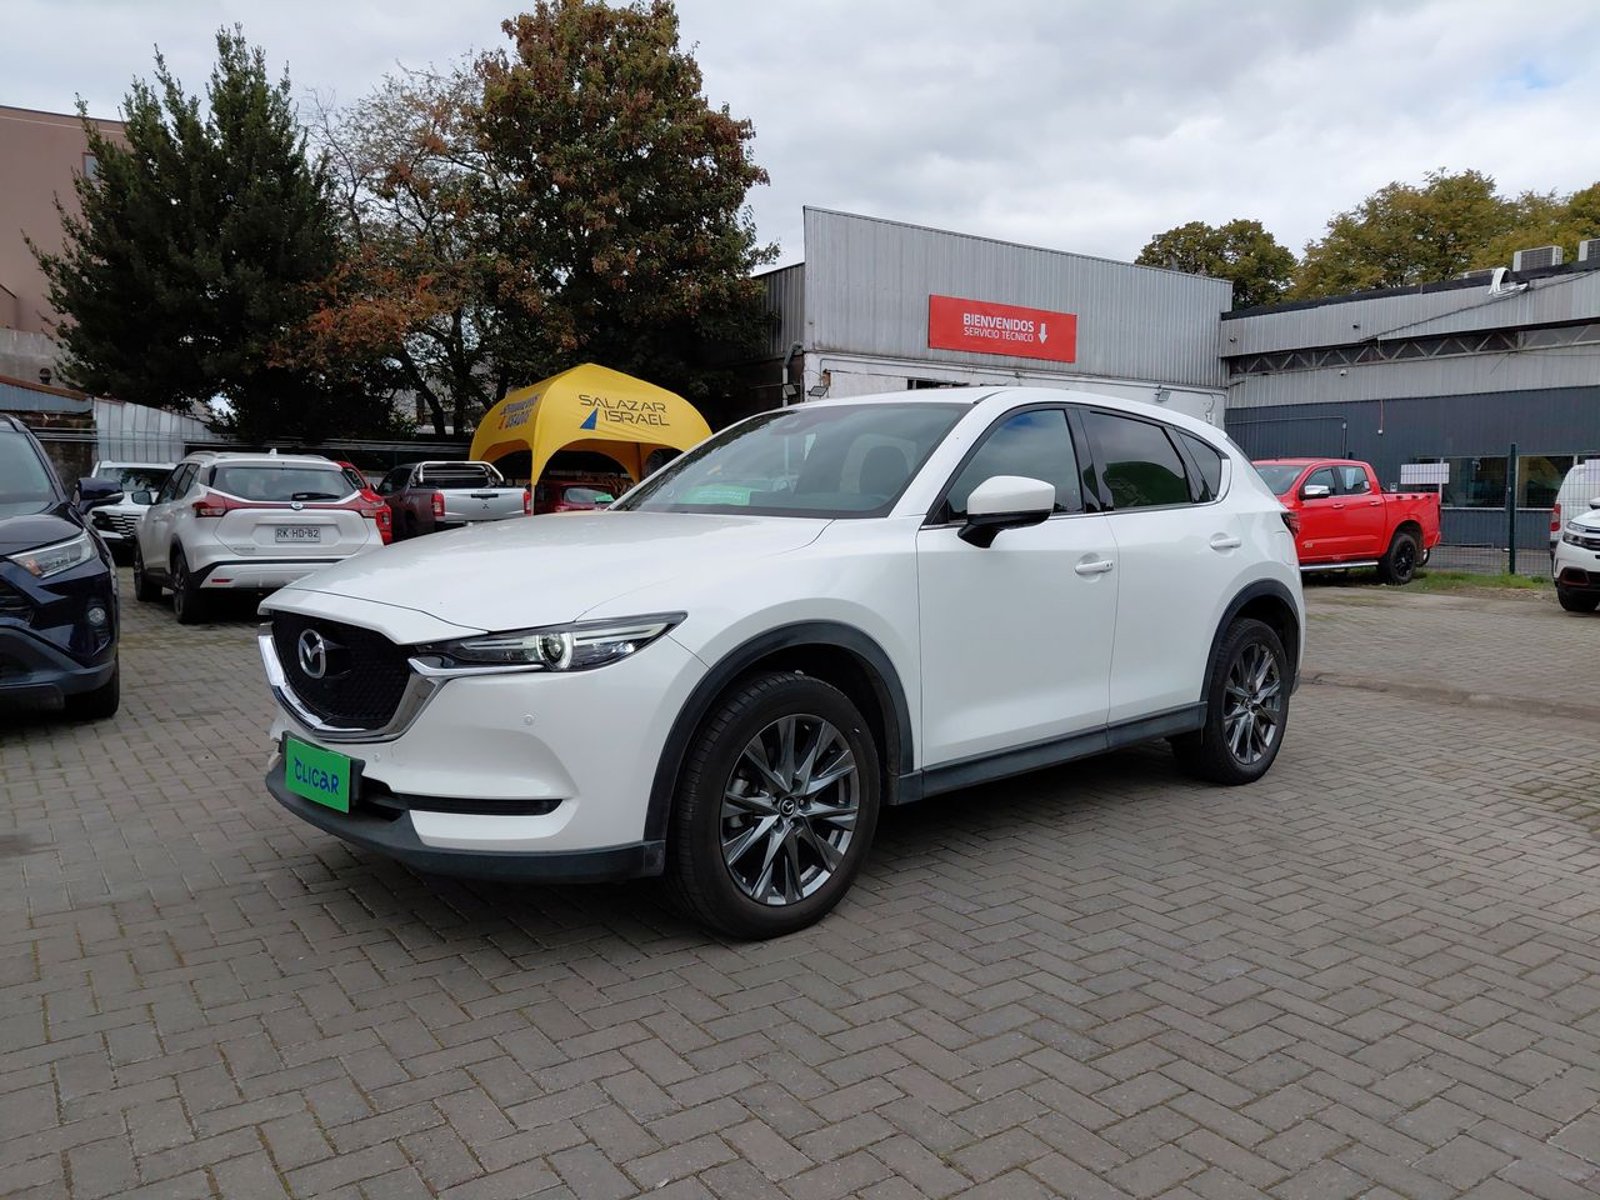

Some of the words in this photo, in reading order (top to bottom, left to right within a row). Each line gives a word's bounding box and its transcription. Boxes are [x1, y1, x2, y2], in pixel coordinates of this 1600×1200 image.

[963, 313, 1034, 333] BIENVENIDOS
[963, 326, 1000, 339] SERVICIO
[578, 394, 666, 412] SALAZAR
[604, 410, 670, 426] ISRAEL
